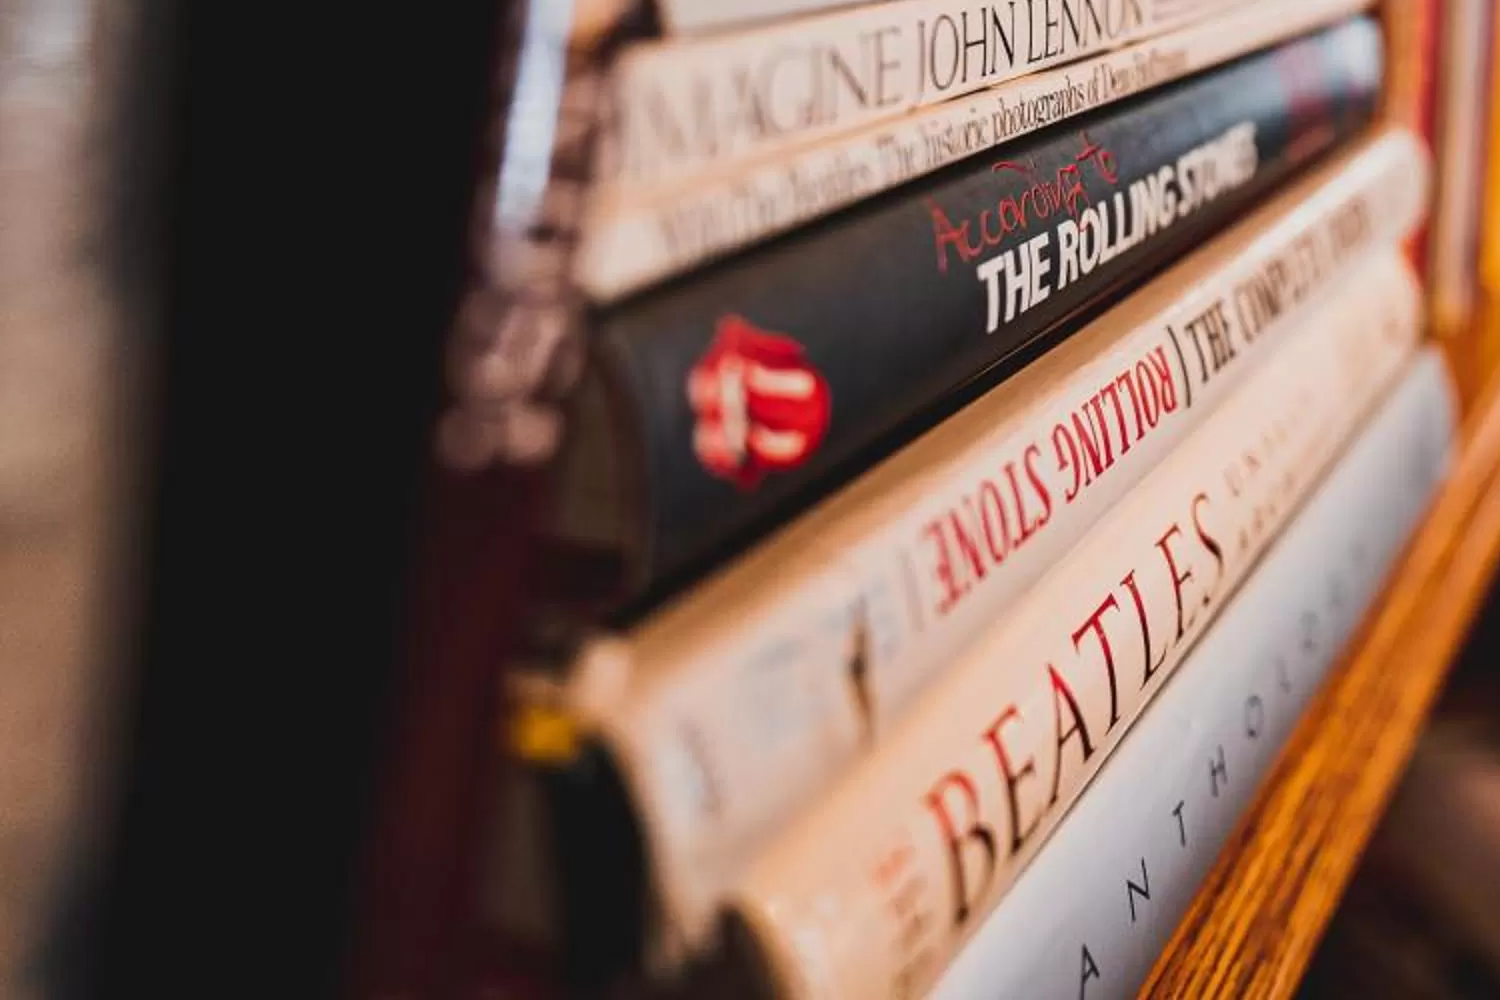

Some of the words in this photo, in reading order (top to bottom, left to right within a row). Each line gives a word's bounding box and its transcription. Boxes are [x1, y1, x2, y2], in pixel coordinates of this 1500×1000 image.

[917, 104, 990, 170] historic
[991, 74, 1086, 145] photographs
[1086, 62, 1103, 99] of
[926, 160, 1089, 275] According
[1074, 130, 1119, 184] to
[977, 231, 1051, 335] THE
[1056, 163, 1176, 290] ROLLING
[1184, 295, 1237, 385] THE
[1051, 345, 1179, 505] ROLLING
[923, 440, 1053, 615] STONE
[921, 490, 1227, 928] BEATLES
